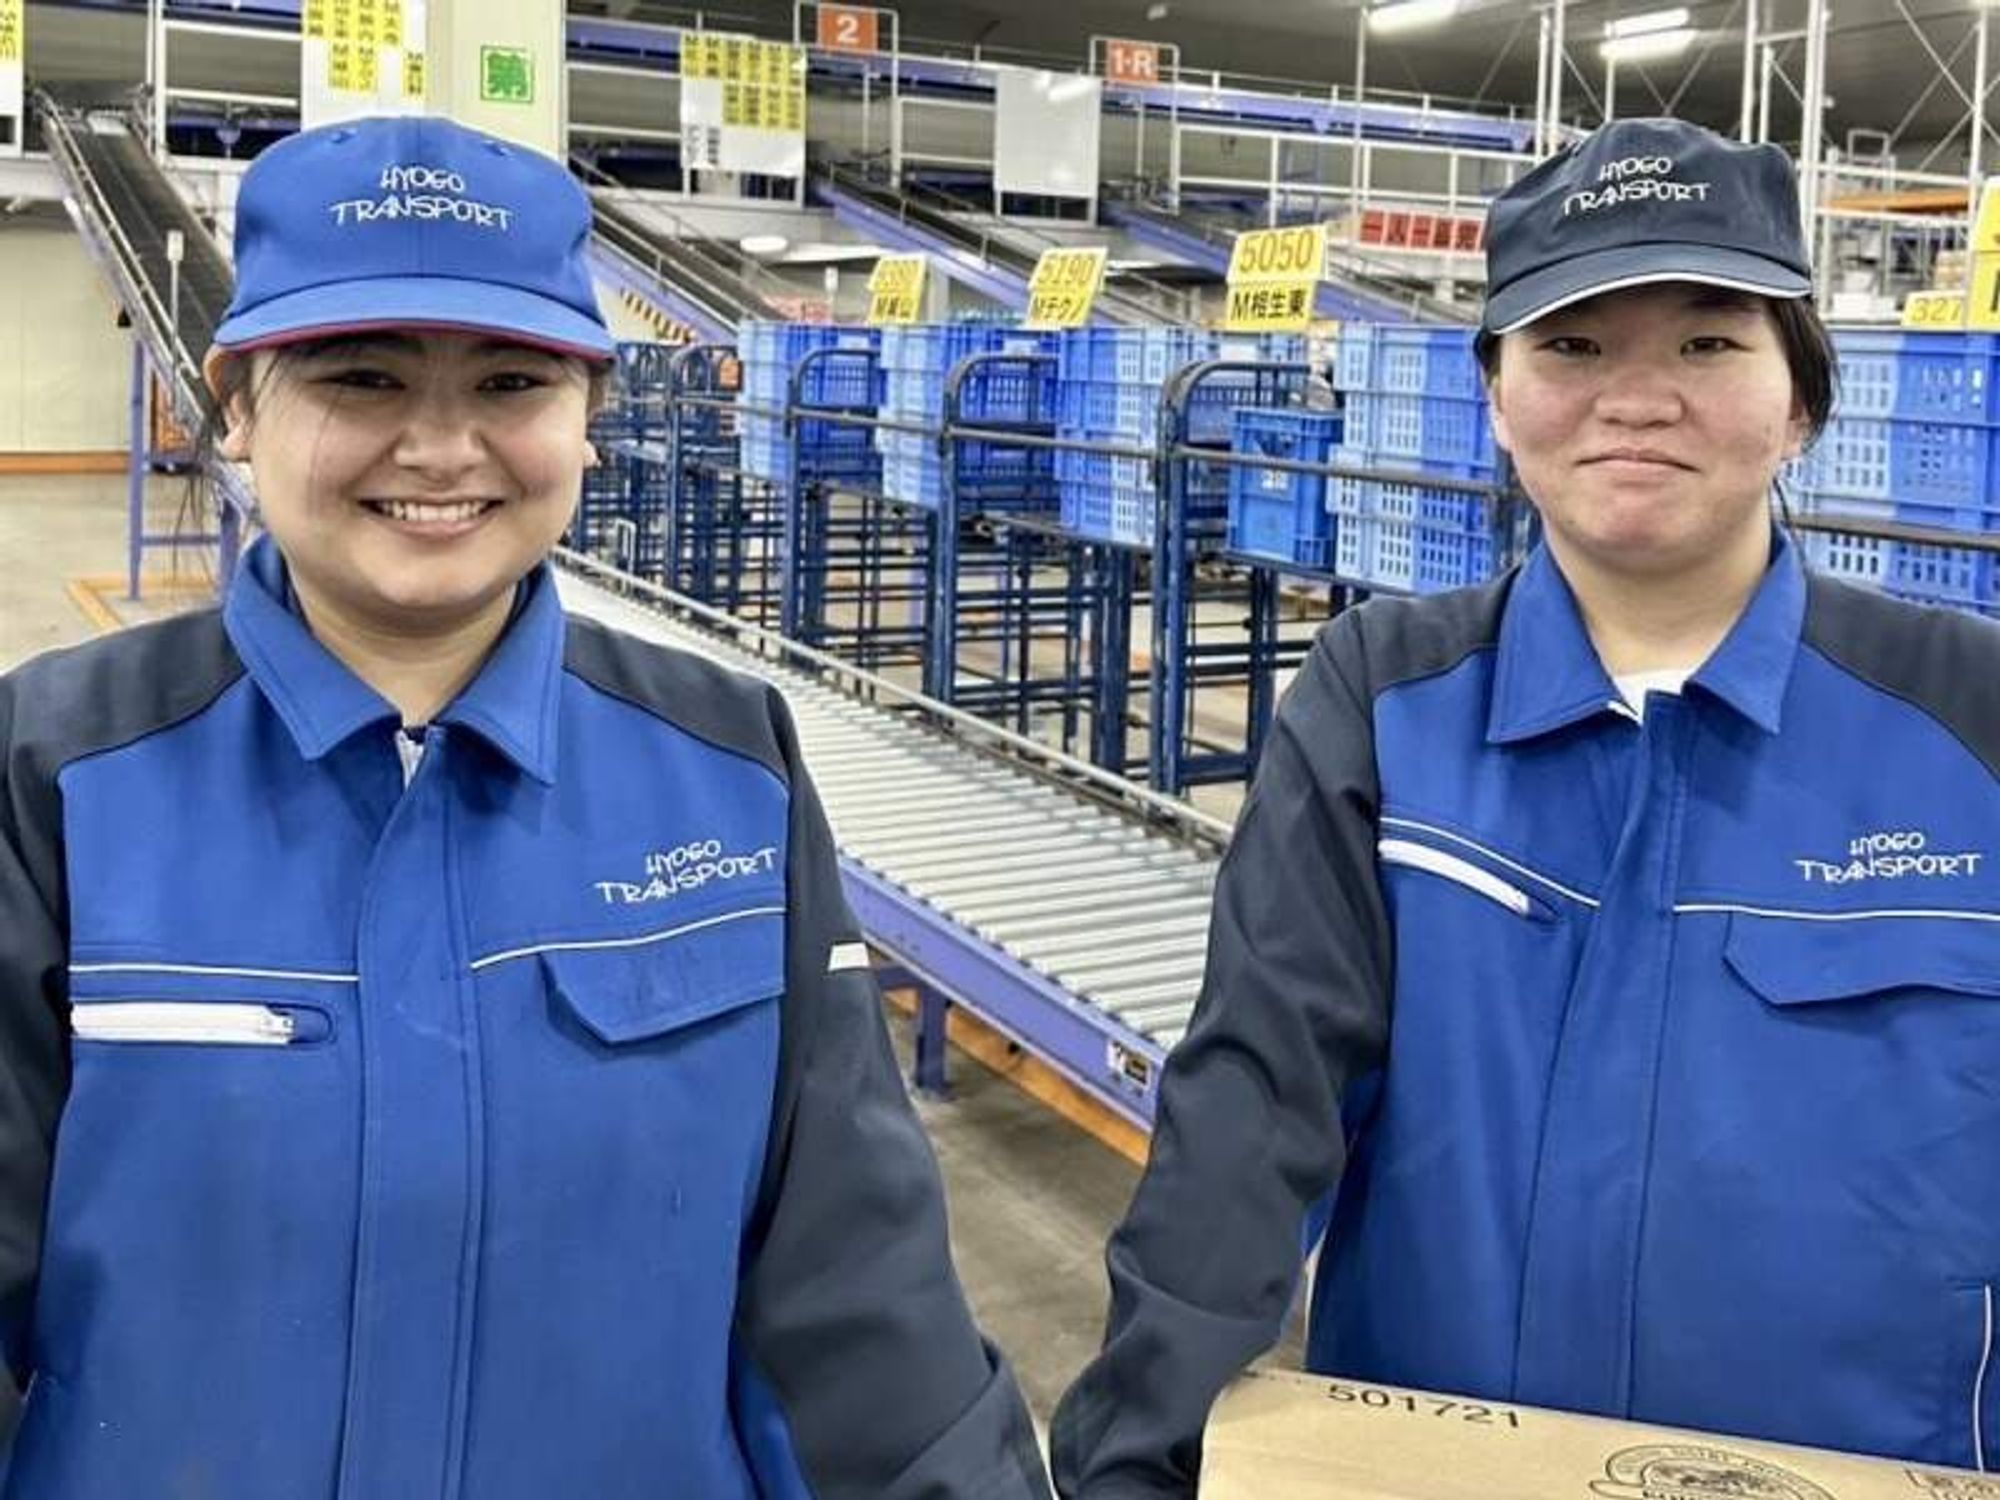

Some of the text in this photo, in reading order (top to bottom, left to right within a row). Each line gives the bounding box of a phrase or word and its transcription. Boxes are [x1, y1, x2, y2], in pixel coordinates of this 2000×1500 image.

[836, 15, 860, 44] 2
[1111, 48, 1153, 77] 1-R
[380, 165, 466, 193] HYOGO
[1597, 156, 1673, 182] HYOGO
[329, 194, 513, 231] TRANSPORT
[1563, 179, 1711, 216] TRANSPORT
[1238, 230, 1316, 273] 5050
[645, 839, 722, 875] HYOGO
[1850, 831, 1925, 856] HYOGO
[595, 847, 777, 904] TRANSPORT
[1794, 853, 1982, 884] TRANSPORT
[1327, 1384, 1519, 1429] 501721
